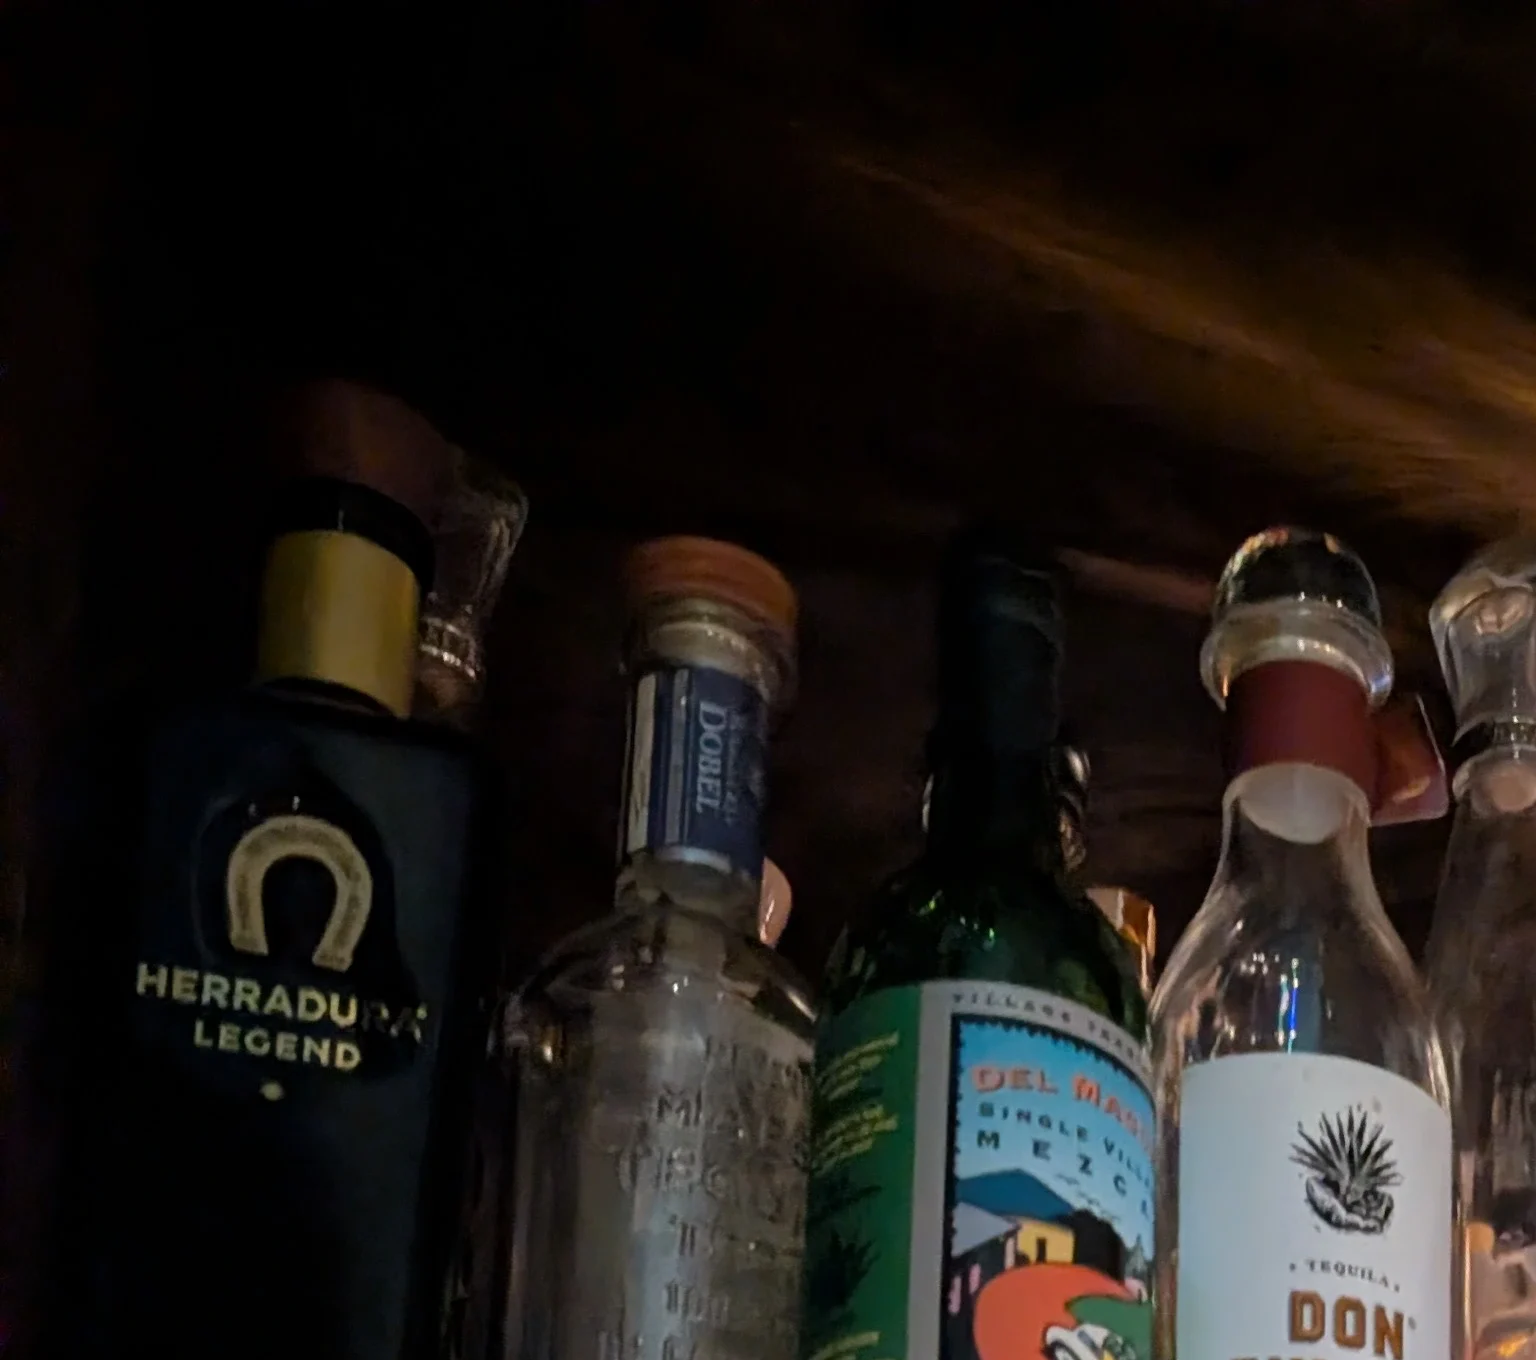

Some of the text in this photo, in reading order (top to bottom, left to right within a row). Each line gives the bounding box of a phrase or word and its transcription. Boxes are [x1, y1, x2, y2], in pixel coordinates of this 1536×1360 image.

[696, 701, 727, 814] DOBEL
[194, 1018, 362, 1072] LEGEND
[972, 1065, 1059, 1096] DEL
[978, 1101, 1089, 1143] SINGLE
[1305, 1257, 1391, 1289] TEQUILA
